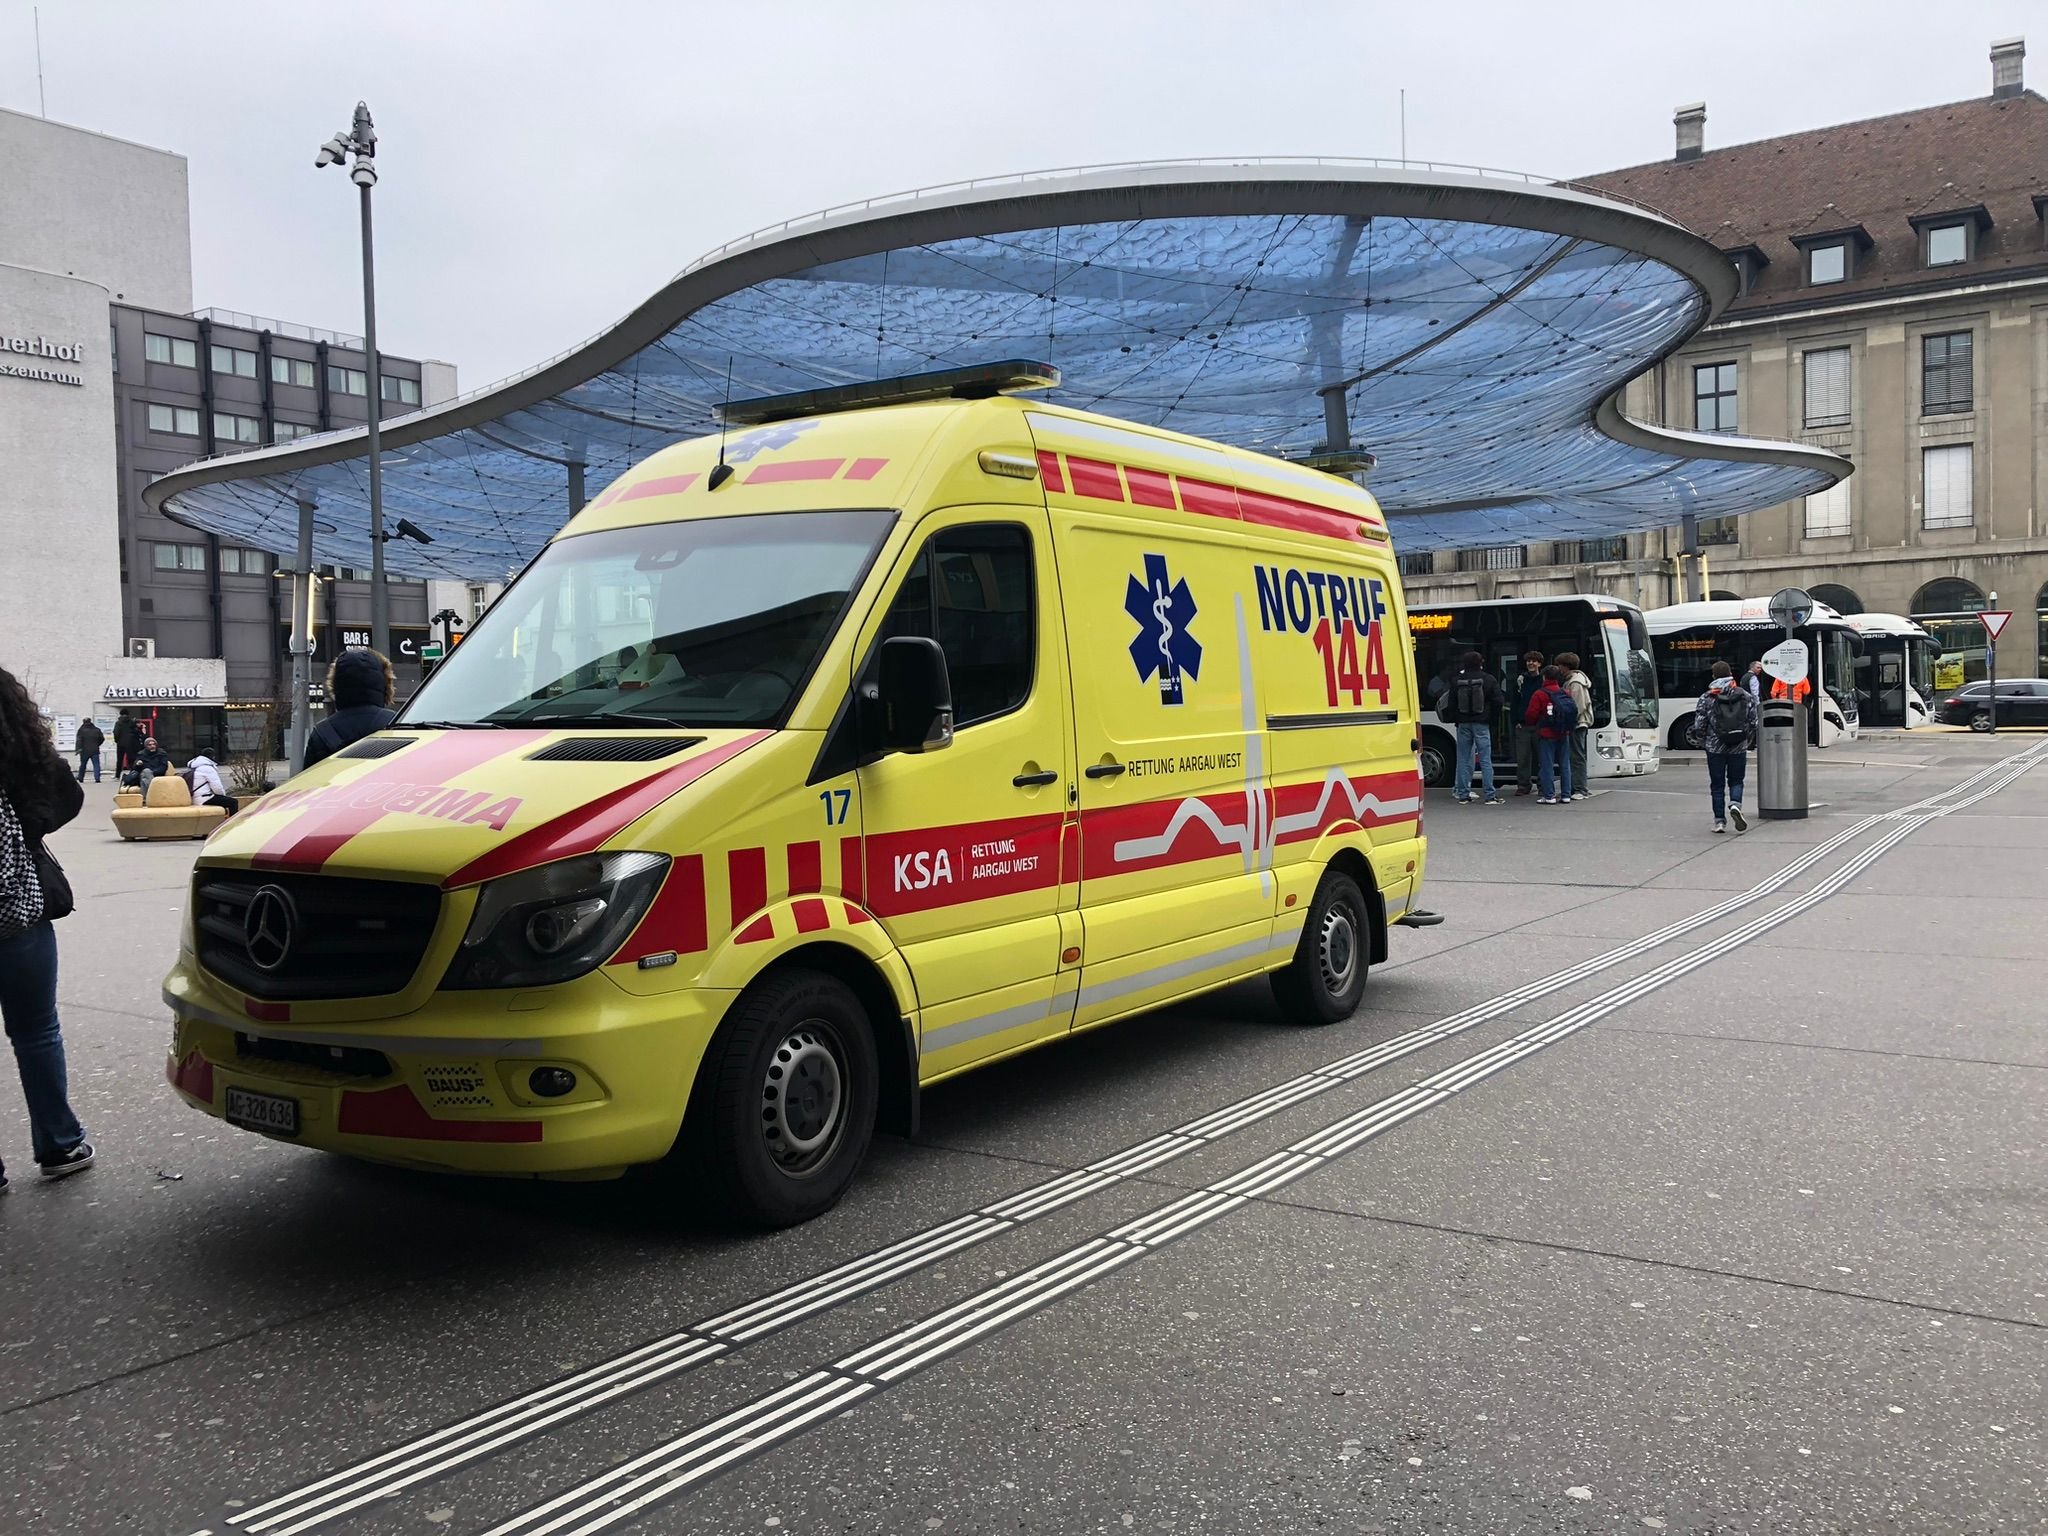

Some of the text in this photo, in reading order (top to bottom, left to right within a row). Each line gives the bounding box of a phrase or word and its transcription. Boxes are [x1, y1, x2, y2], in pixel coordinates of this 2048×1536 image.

[1254, 565, 1386, 636] NOTRUF
[343, 631, 369, 645] BAR &
[1669, 641, 1675, 649] 3
[1312, 618, 1390, 707] 144
[105, 684, 202, 698] Aarauerhof
[1128, 752, 1241, 777] RETTUNG AARGAU WEST
[819, 789, 851, 826] 17
[971, 839, 1016, 859] RETTUNG
[894, 848, 952, 893] KSA
[972, 856, 1039, 880] AARGAU WEST
[427, 1078, 475, 1092] BAUS
